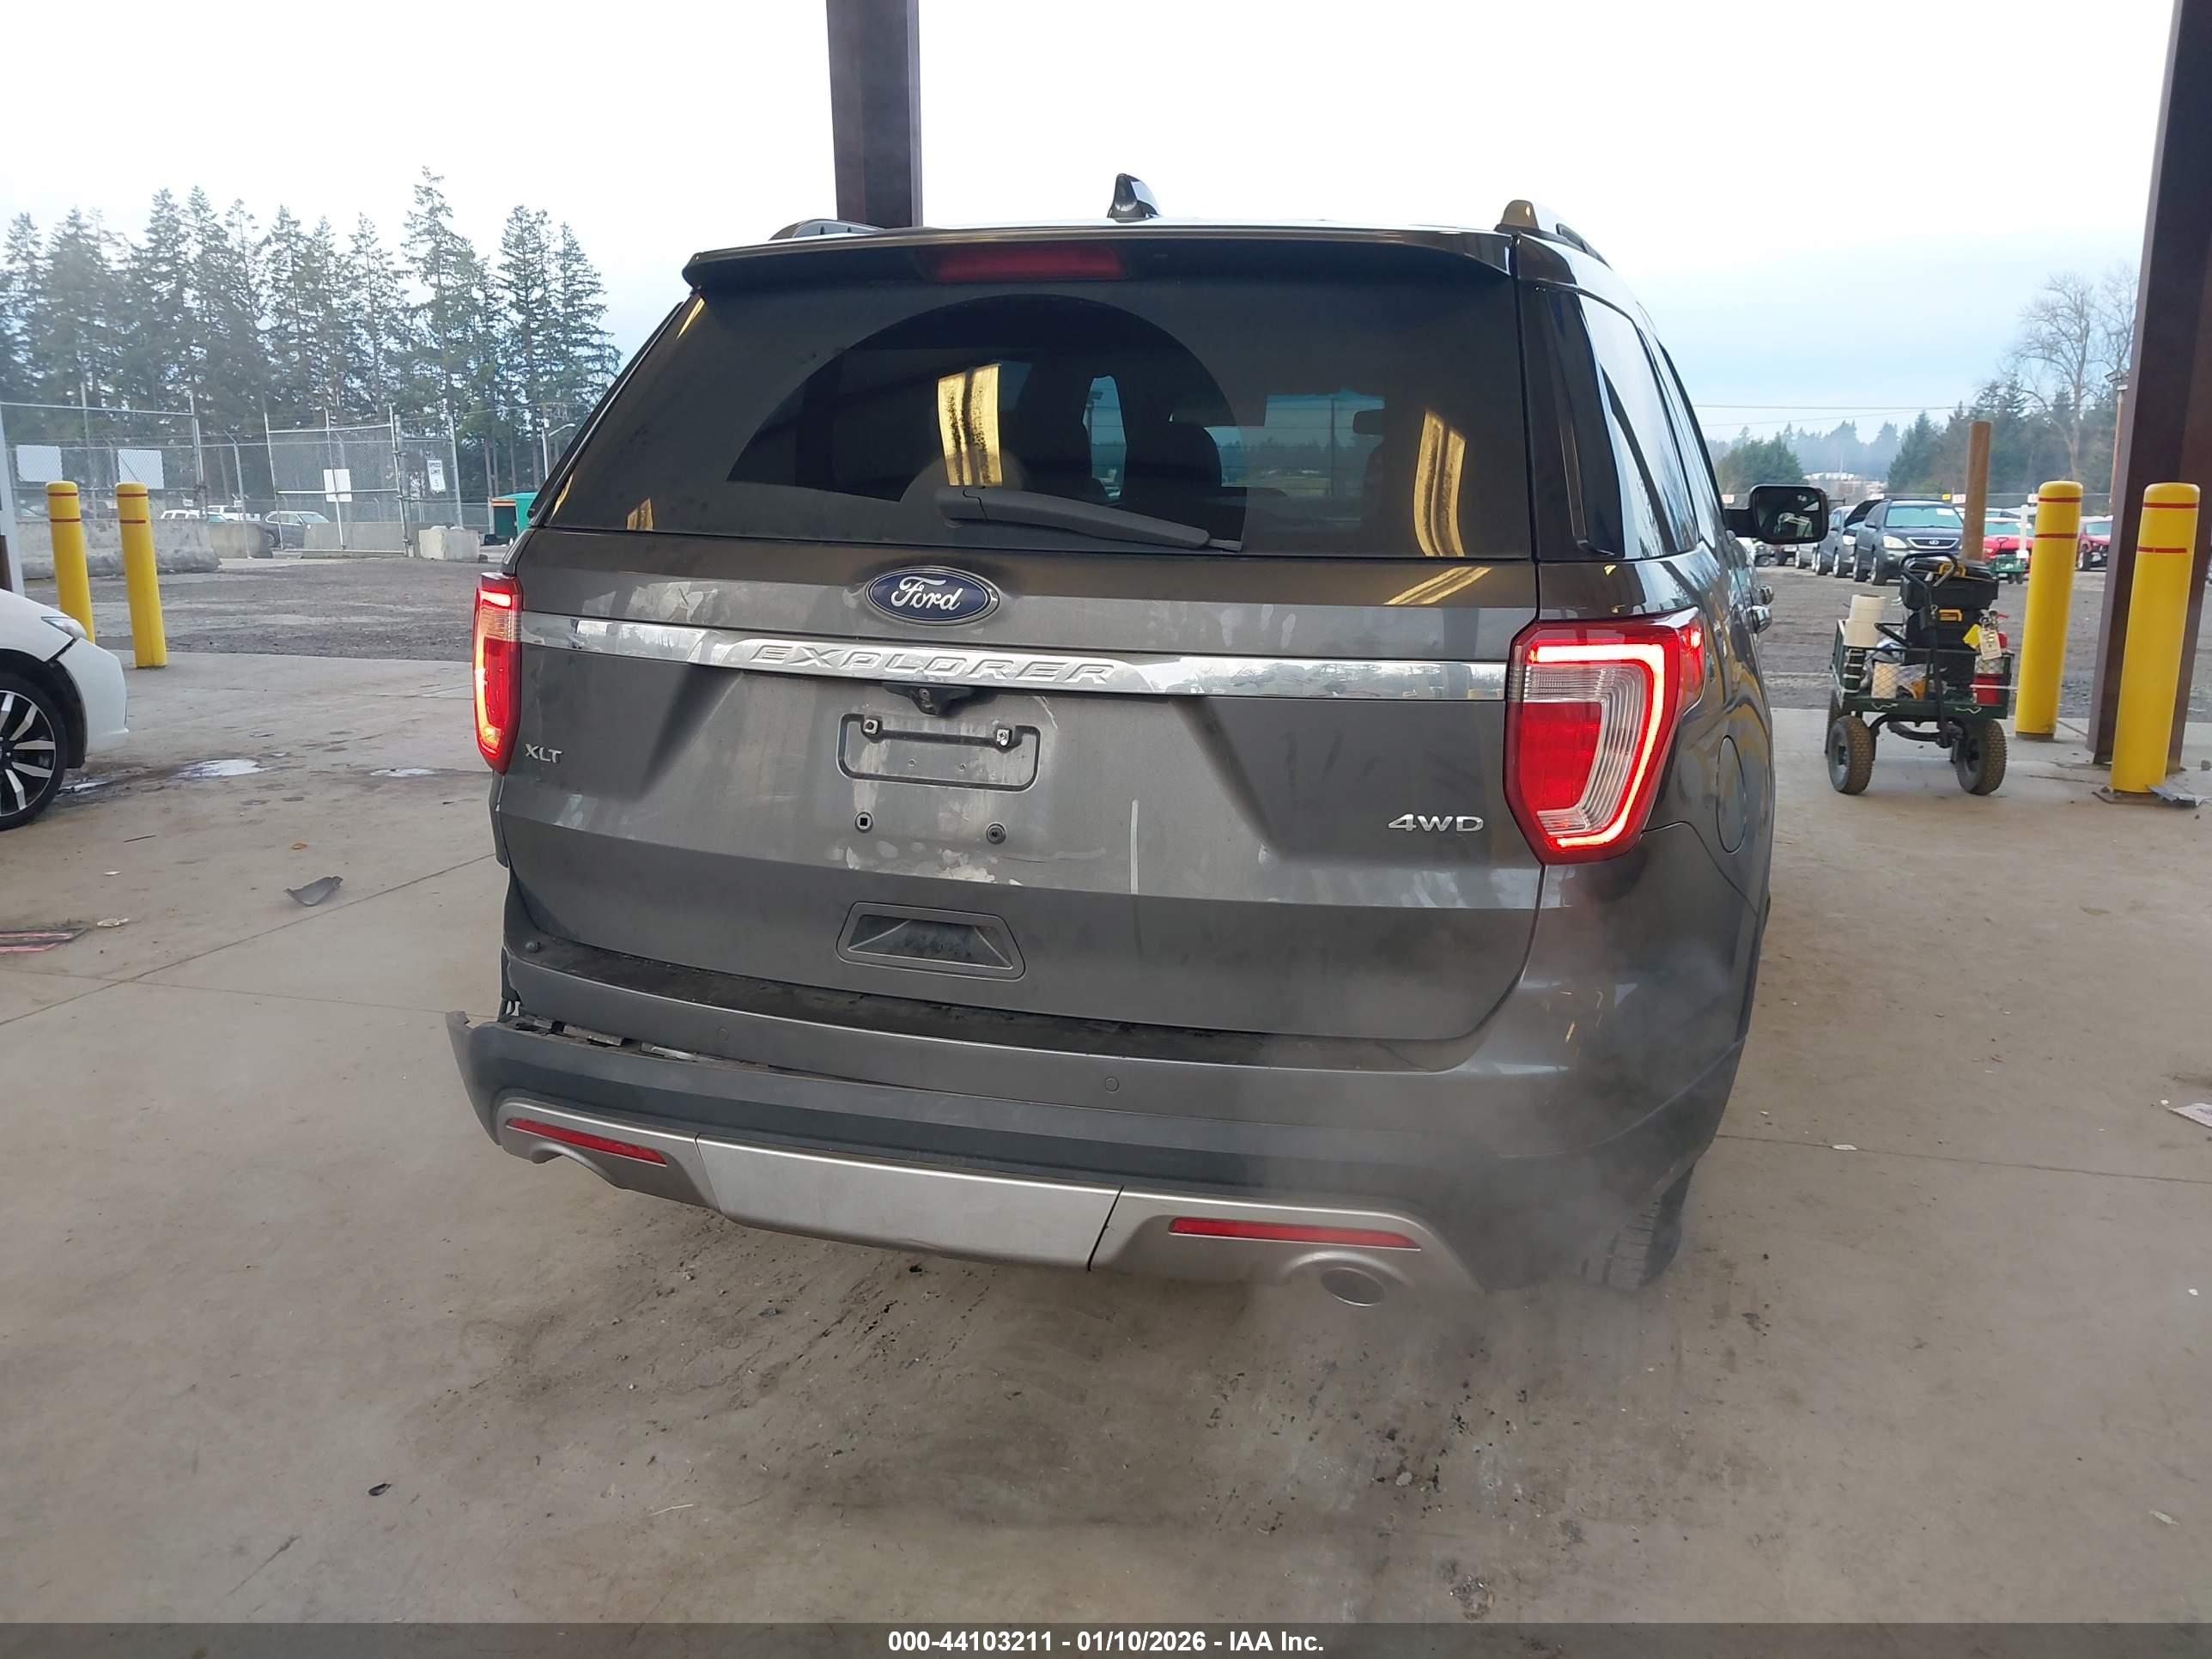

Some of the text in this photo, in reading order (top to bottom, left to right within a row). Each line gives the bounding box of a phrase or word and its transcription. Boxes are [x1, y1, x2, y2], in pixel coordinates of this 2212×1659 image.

[890, 575, 962, 612] Ford
[748, 644, 1117, 685] EXPLORER
[525, 743, 563, 763] XLT
[1388, 813, 1485, 832] 4WD
